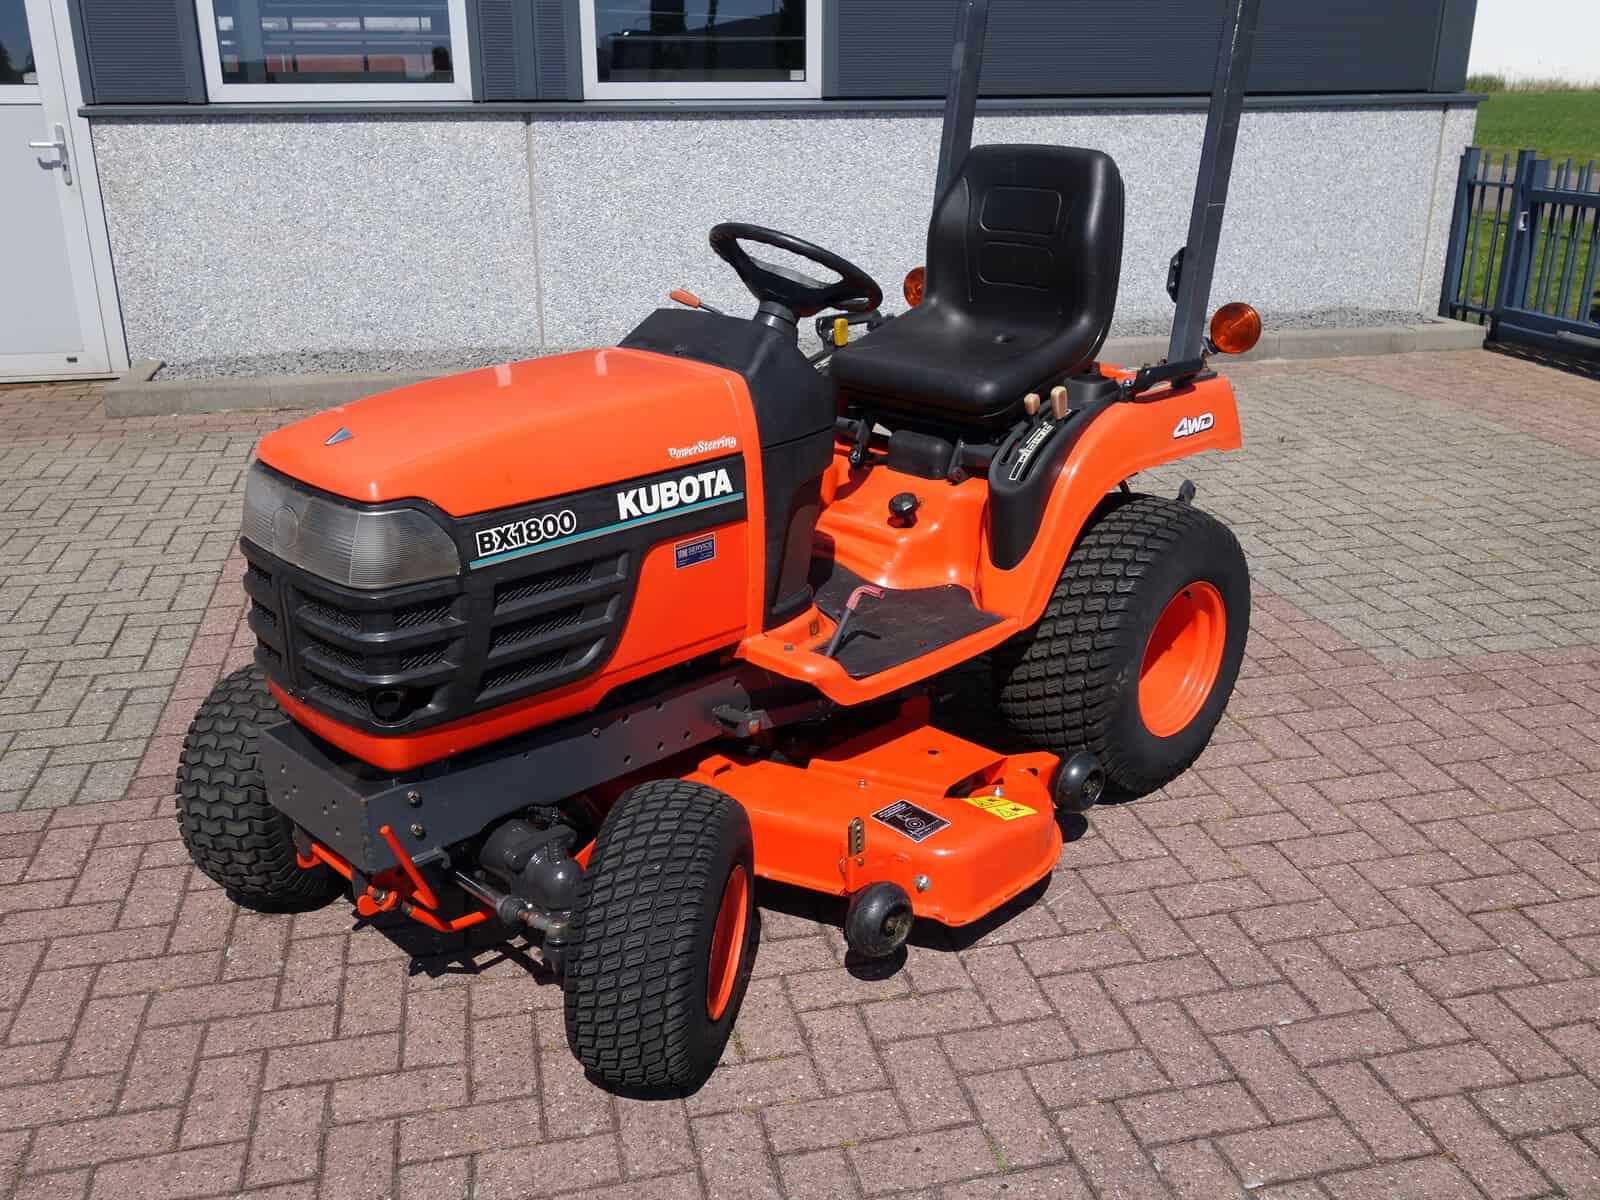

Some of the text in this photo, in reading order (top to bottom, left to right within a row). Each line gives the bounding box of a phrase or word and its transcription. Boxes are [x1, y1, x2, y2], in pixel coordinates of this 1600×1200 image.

[1172, 412, 1215, 439] 4WD
[616, 468, 733, 521] KUBOTA
[475, 509, 577, 557] BX1800
